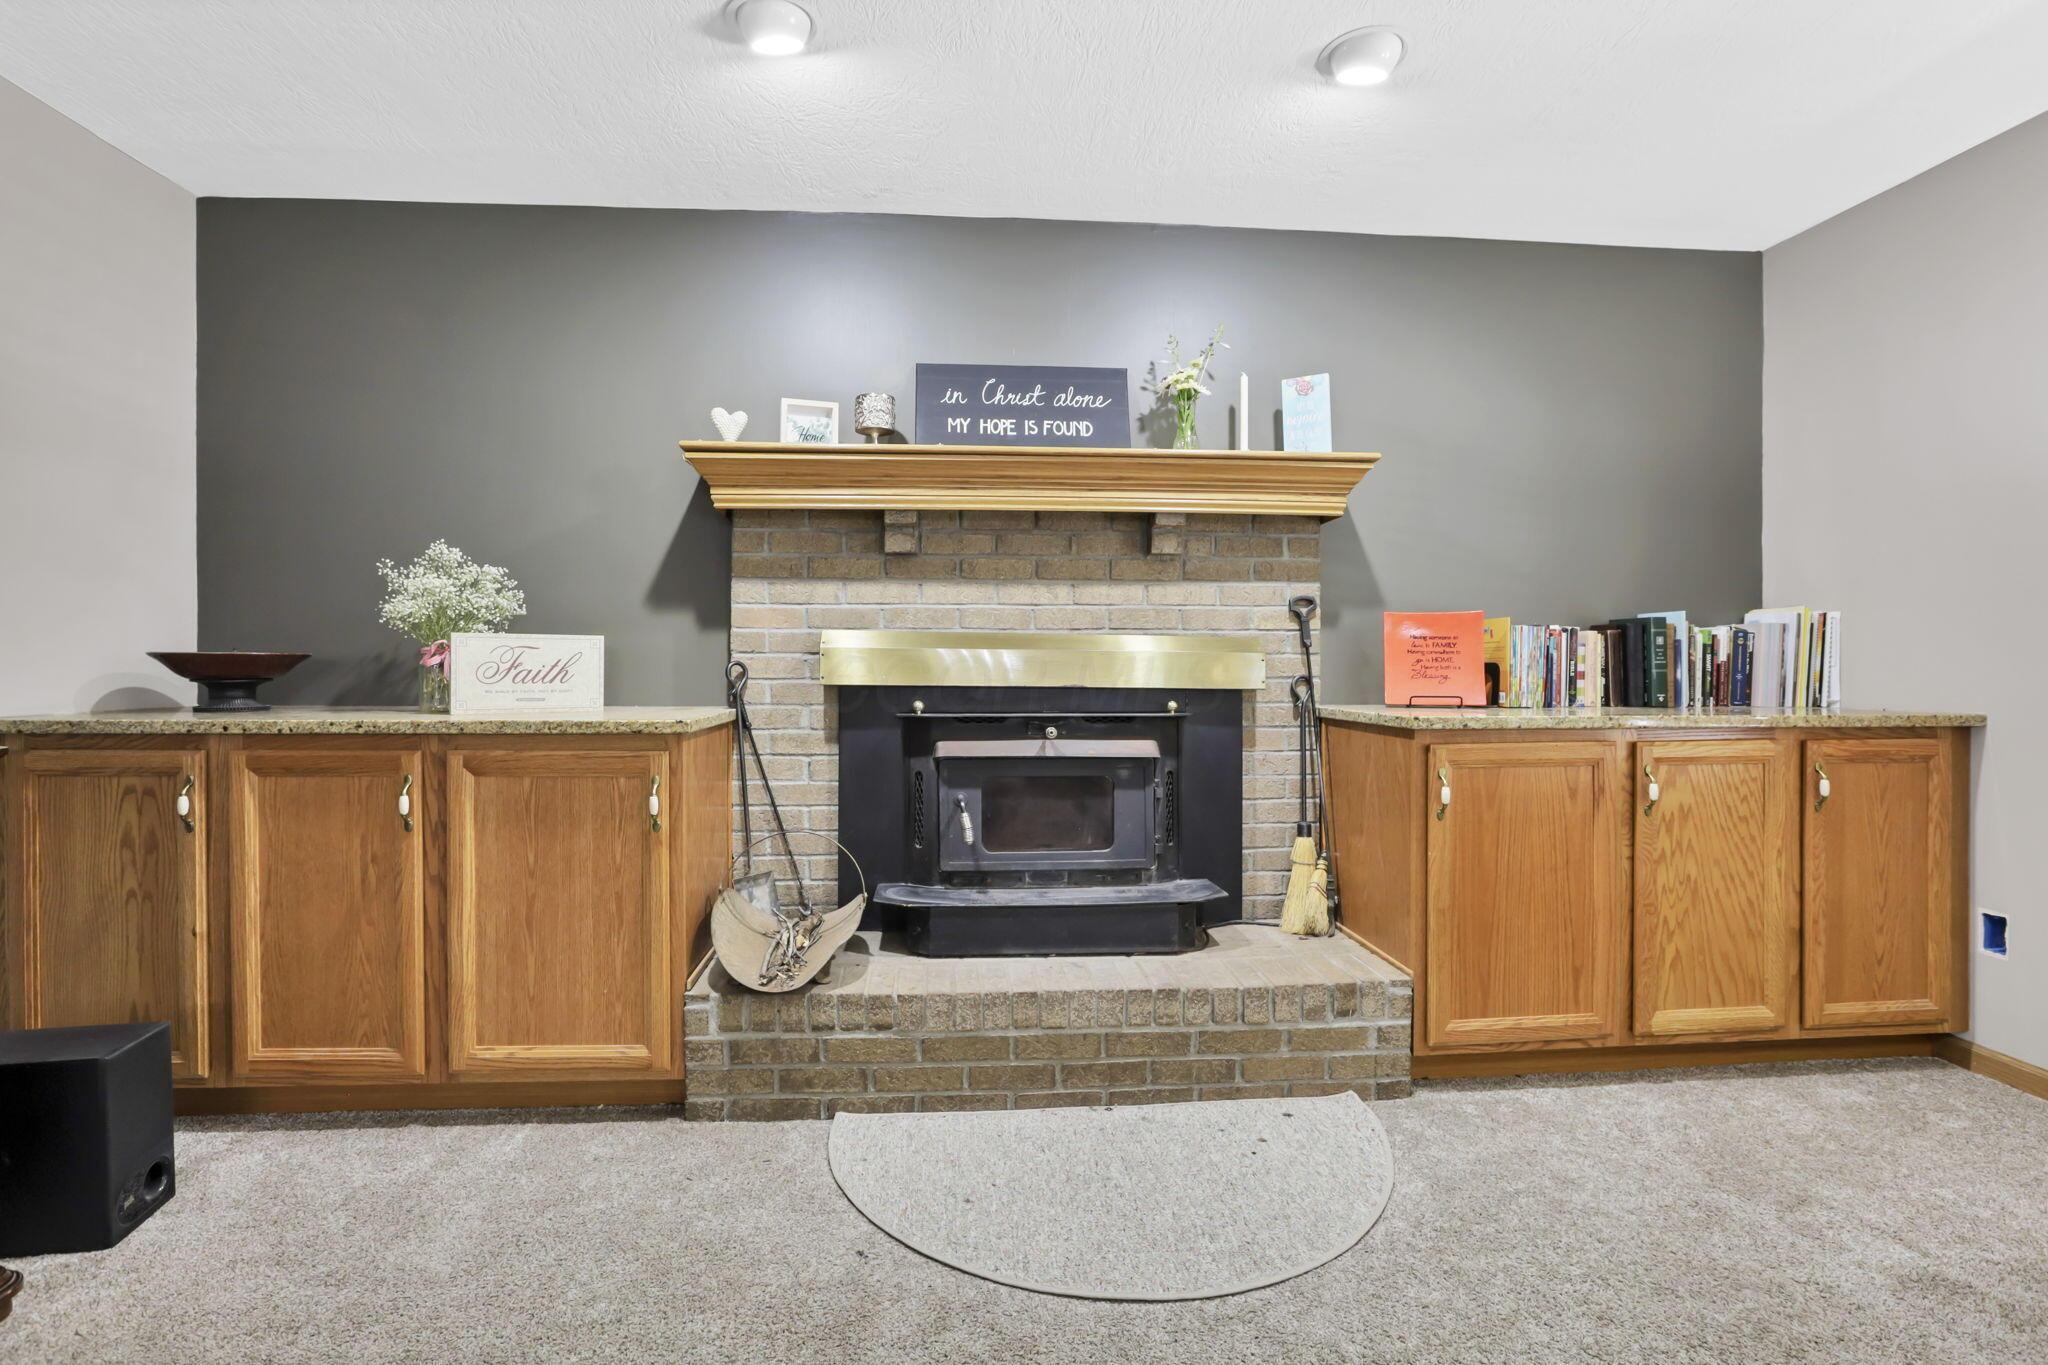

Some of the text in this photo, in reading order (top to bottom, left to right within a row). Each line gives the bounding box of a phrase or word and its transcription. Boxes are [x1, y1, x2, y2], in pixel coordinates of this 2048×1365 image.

[940, 378, 1112, 408] in Christ alone
[793, 424, 826, 444] Home
[947, 417, 1094, 437] MY HOPE IS FOUND
[475, 644, 583, 685] Faith
